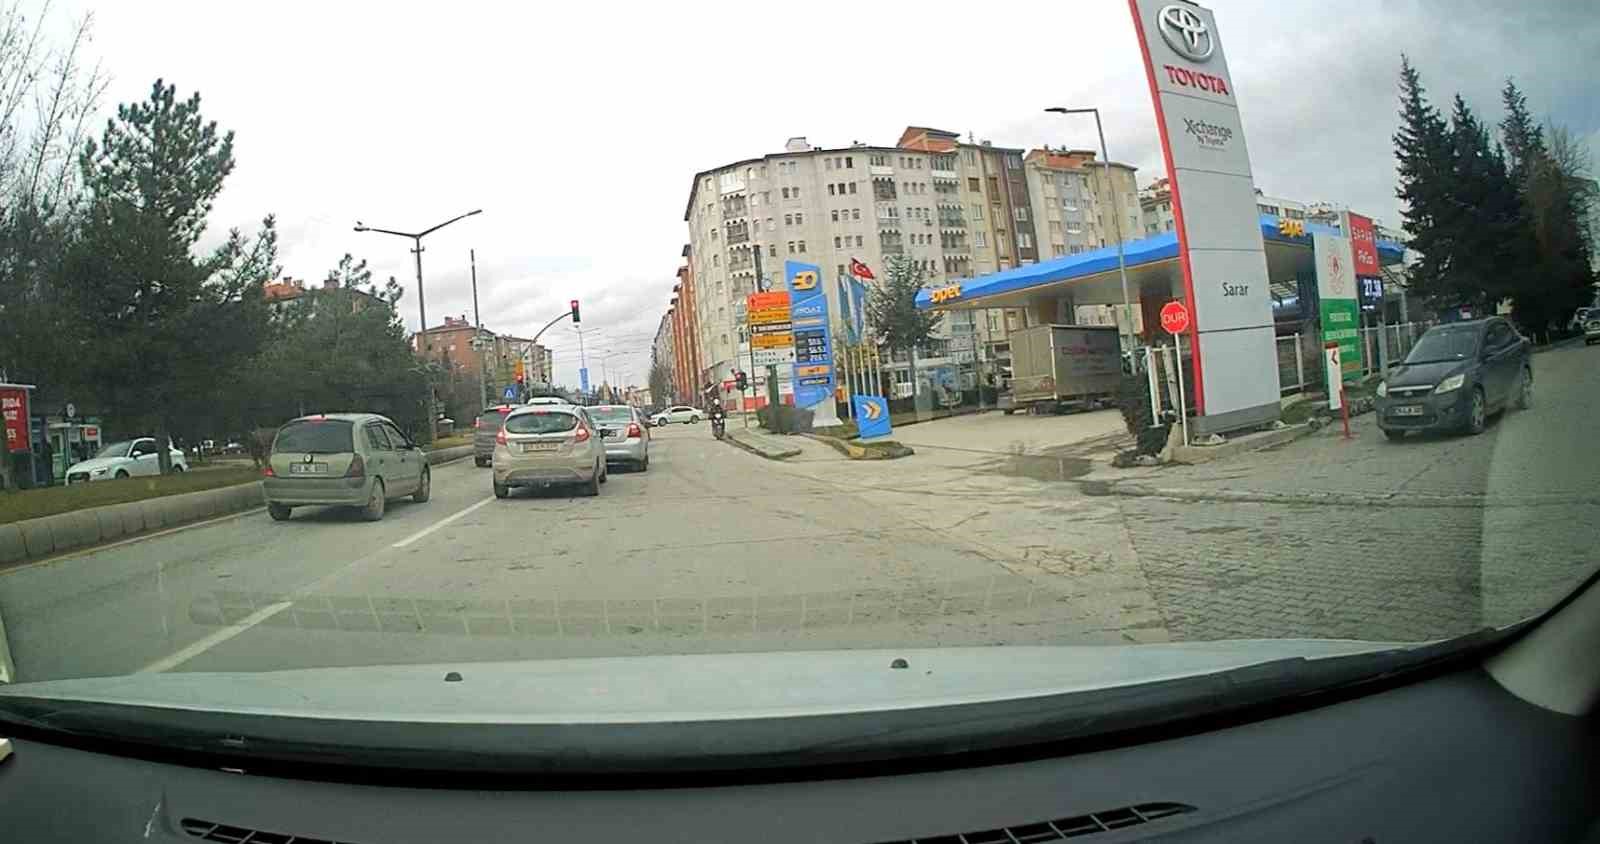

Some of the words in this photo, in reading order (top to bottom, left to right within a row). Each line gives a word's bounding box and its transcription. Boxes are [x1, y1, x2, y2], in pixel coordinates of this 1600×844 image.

[1163, 65, 1229, 95] TOYOTA
[1222, 282, 1249, 297] Sarar
[1163, 311, 1187, 324] DUR
